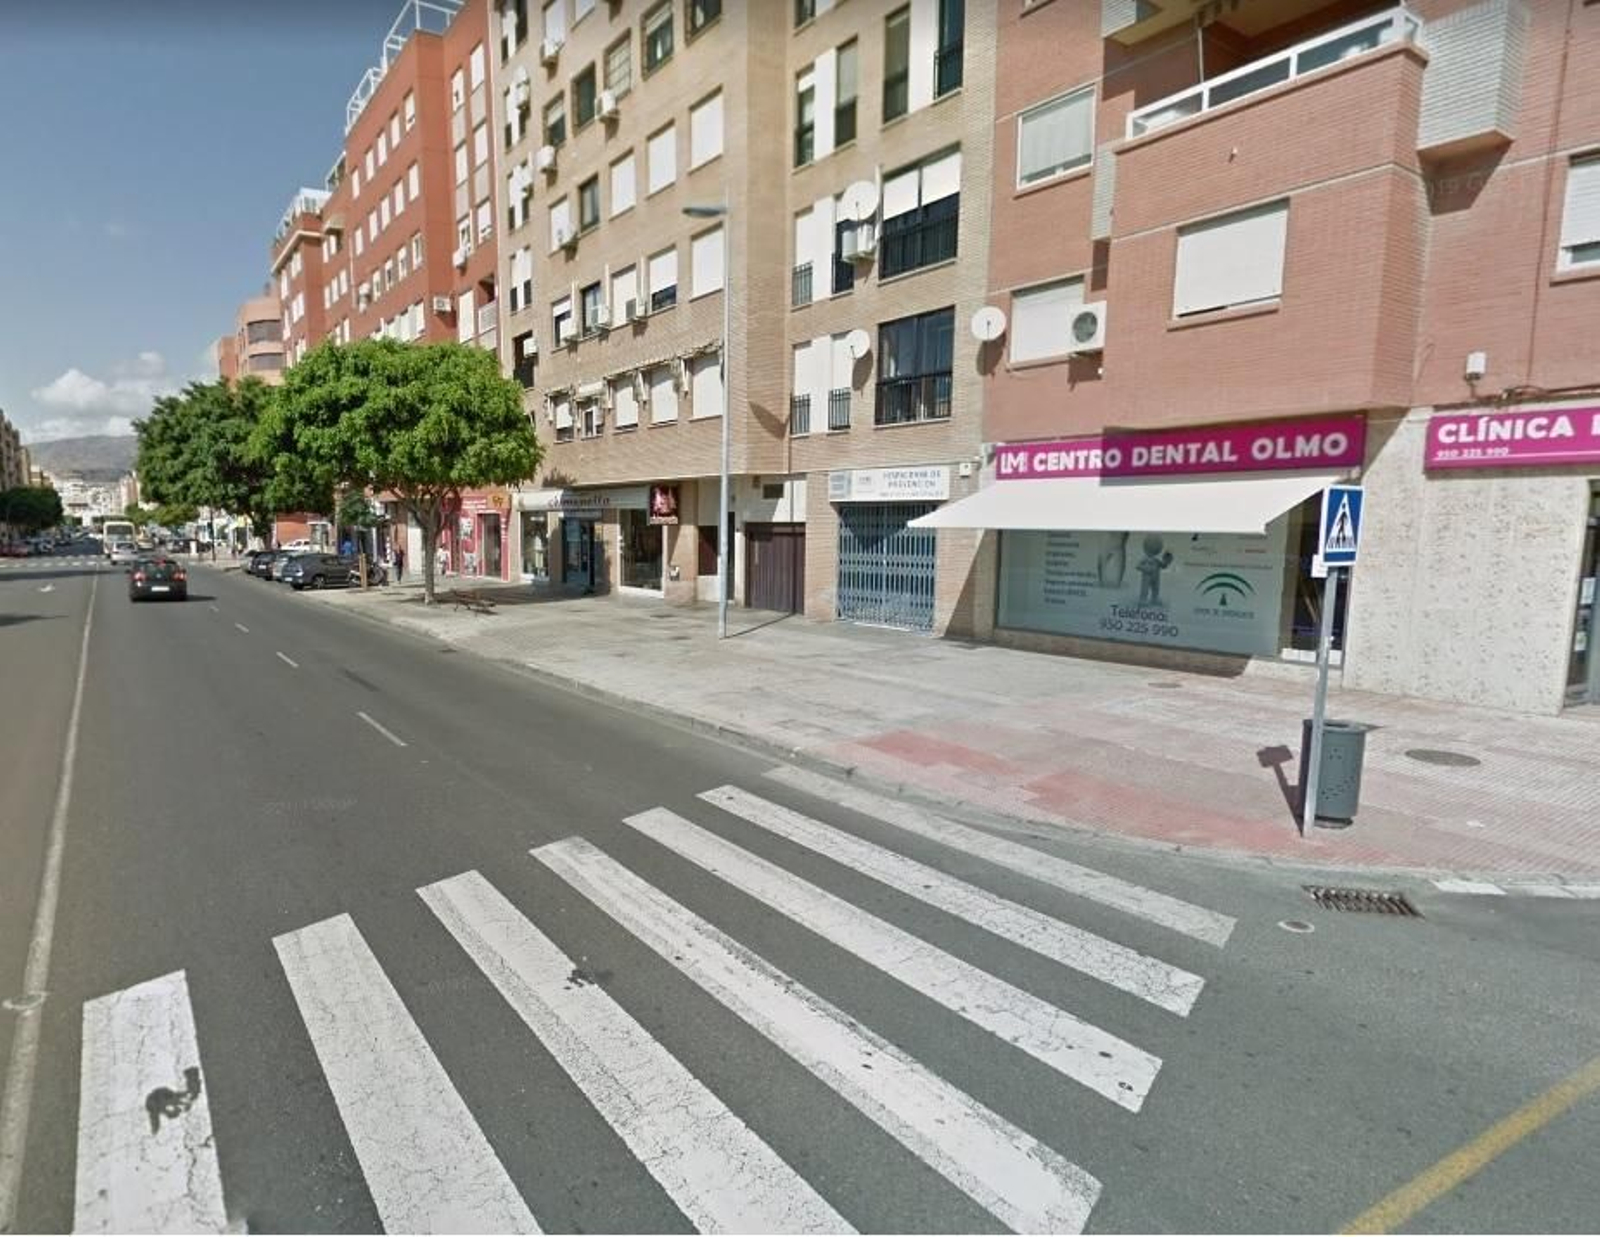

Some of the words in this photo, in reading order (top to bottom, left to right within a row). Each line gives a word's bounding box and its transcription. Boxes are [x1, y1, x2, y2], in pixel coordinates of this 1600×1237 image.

[1438, 416, 1574, 443] CLÍNICA
[1034, 448, 1121, 472] CENTRO
[1131, 441, 1238, 467] DENTAL
[1251, 432, 1348, 460] OLMO
[1126, 621, 1149, 634] 225
[1152, 623, 1179, 637] 990
